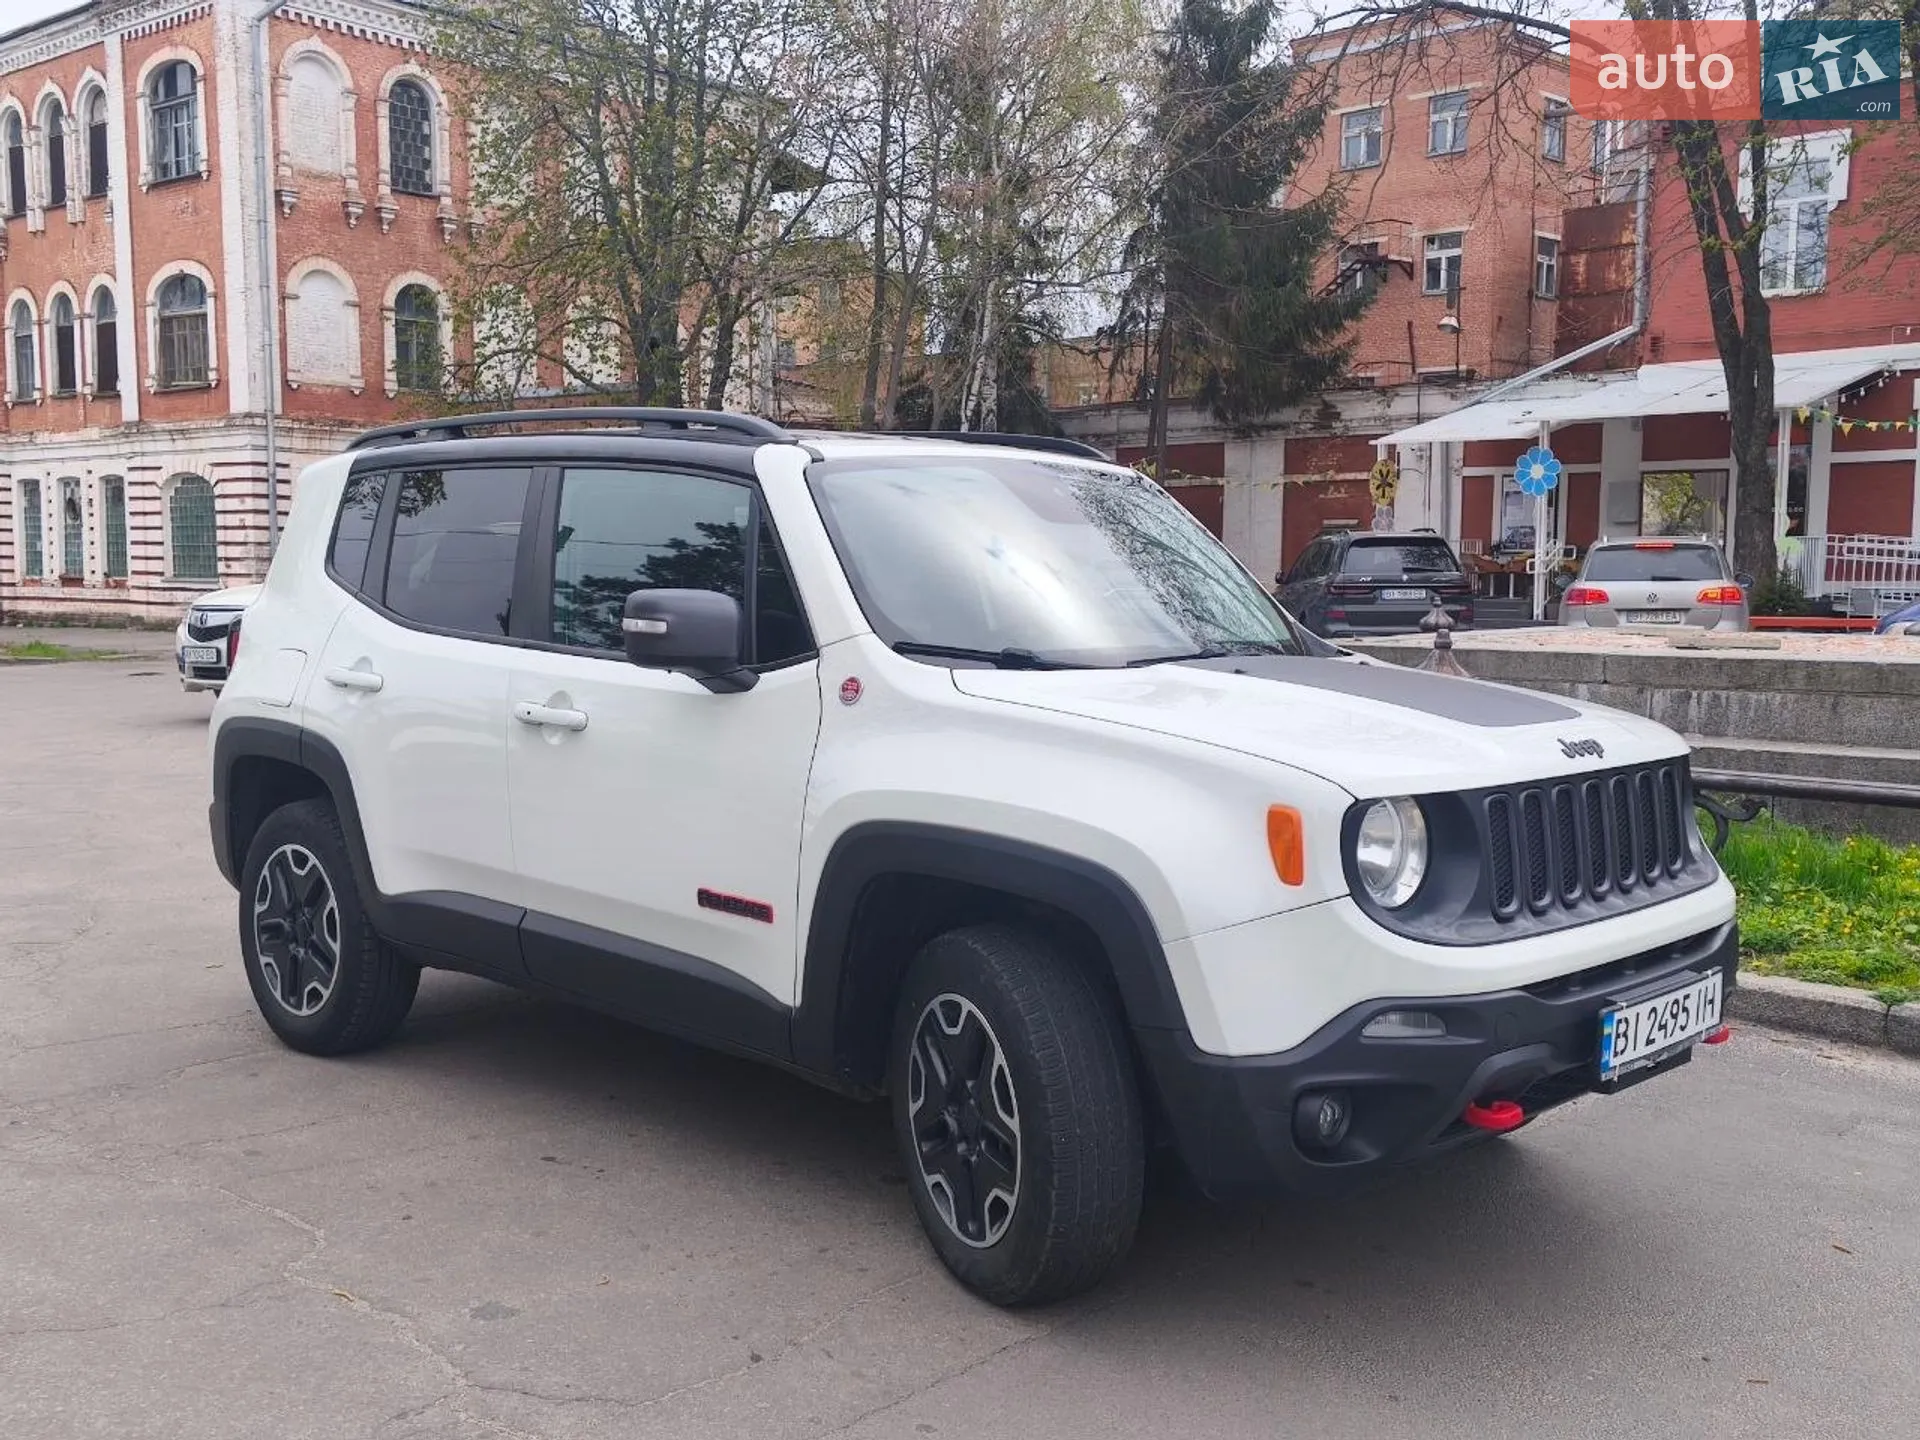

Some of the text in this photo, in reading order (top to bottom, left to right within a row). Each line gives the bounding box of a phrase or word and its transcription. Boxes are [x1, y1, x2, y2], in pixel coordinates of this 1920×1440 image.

[1557, 738, 1604, 758] Jeep
[1613, 982, 1716, 1058] BI 2495 IH
